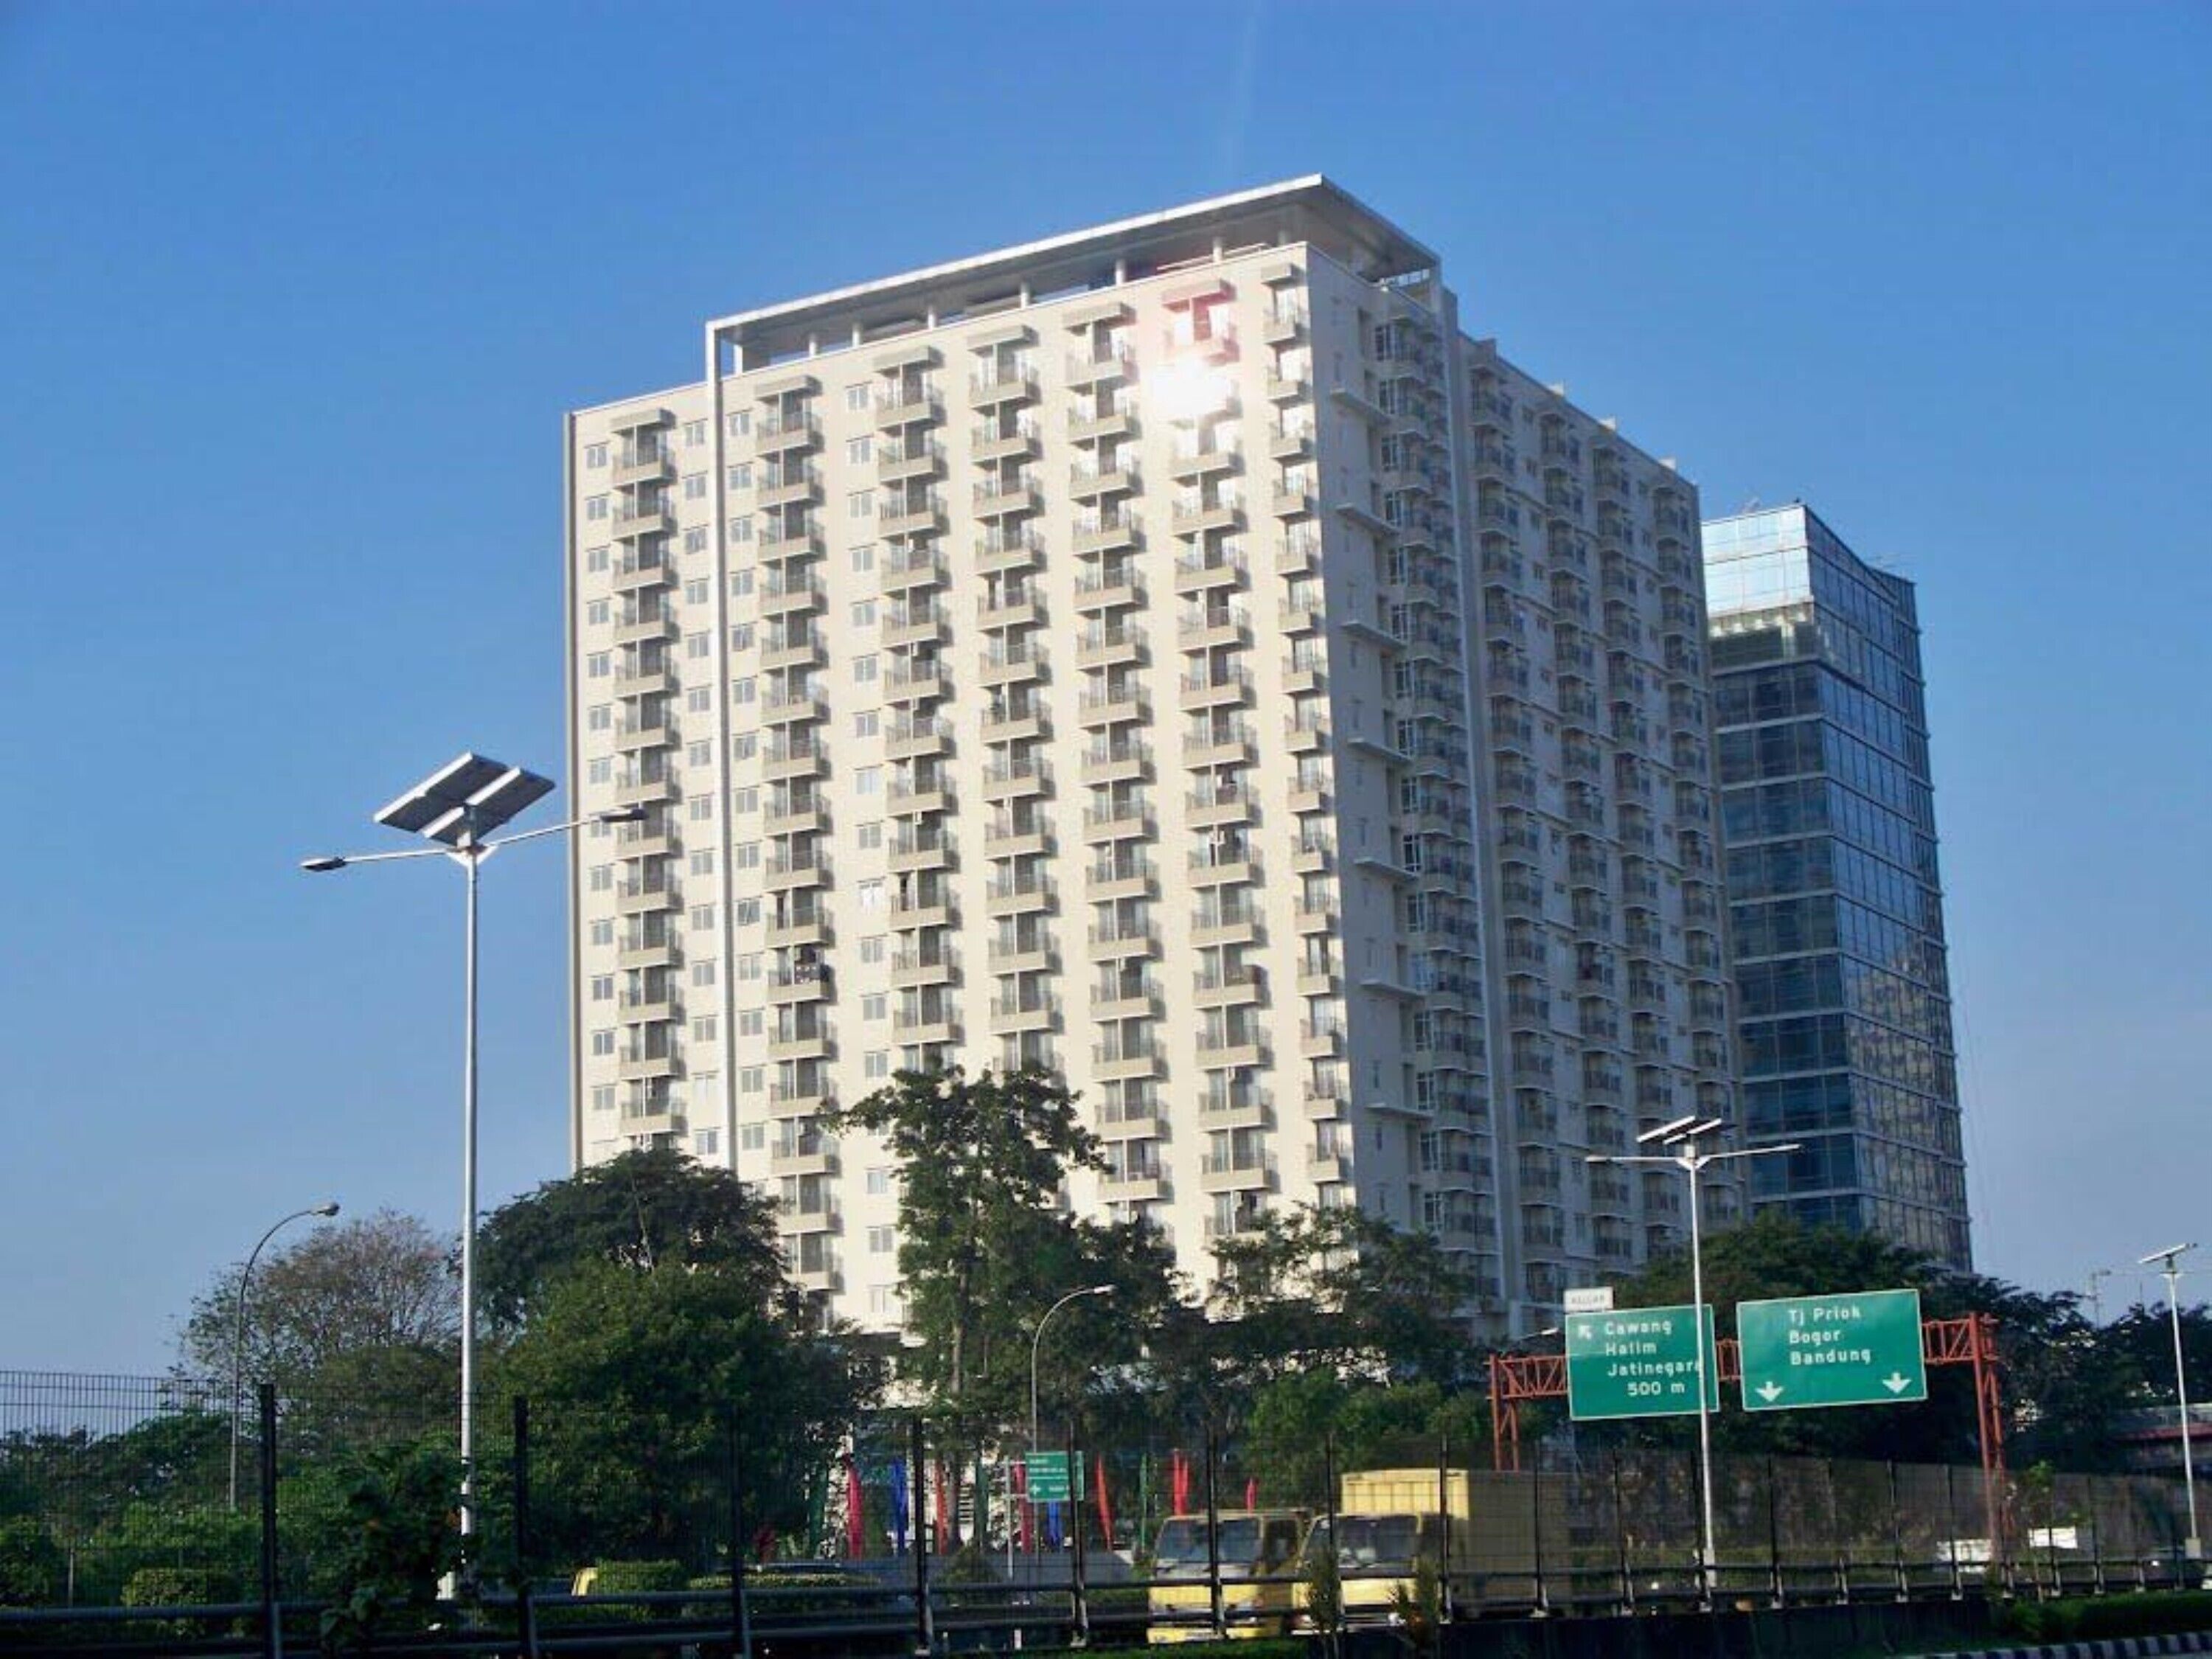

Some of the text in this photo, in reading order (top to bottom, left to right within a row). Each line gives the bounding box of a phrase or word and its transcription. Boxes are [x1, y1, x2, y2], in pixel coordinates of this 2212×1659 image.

[1789, 1305, 1860, 1326] Tj Priok
[1606, 1321, 1672, 1335] Cawang
[1789, 1329, 1840, 1347] Bogor
[1605, 1340, 1657, 1357] Halim
[1790, 1349, 1871, 1365] Bandung
[1627, 1381, 1686, 1397] 500 m
